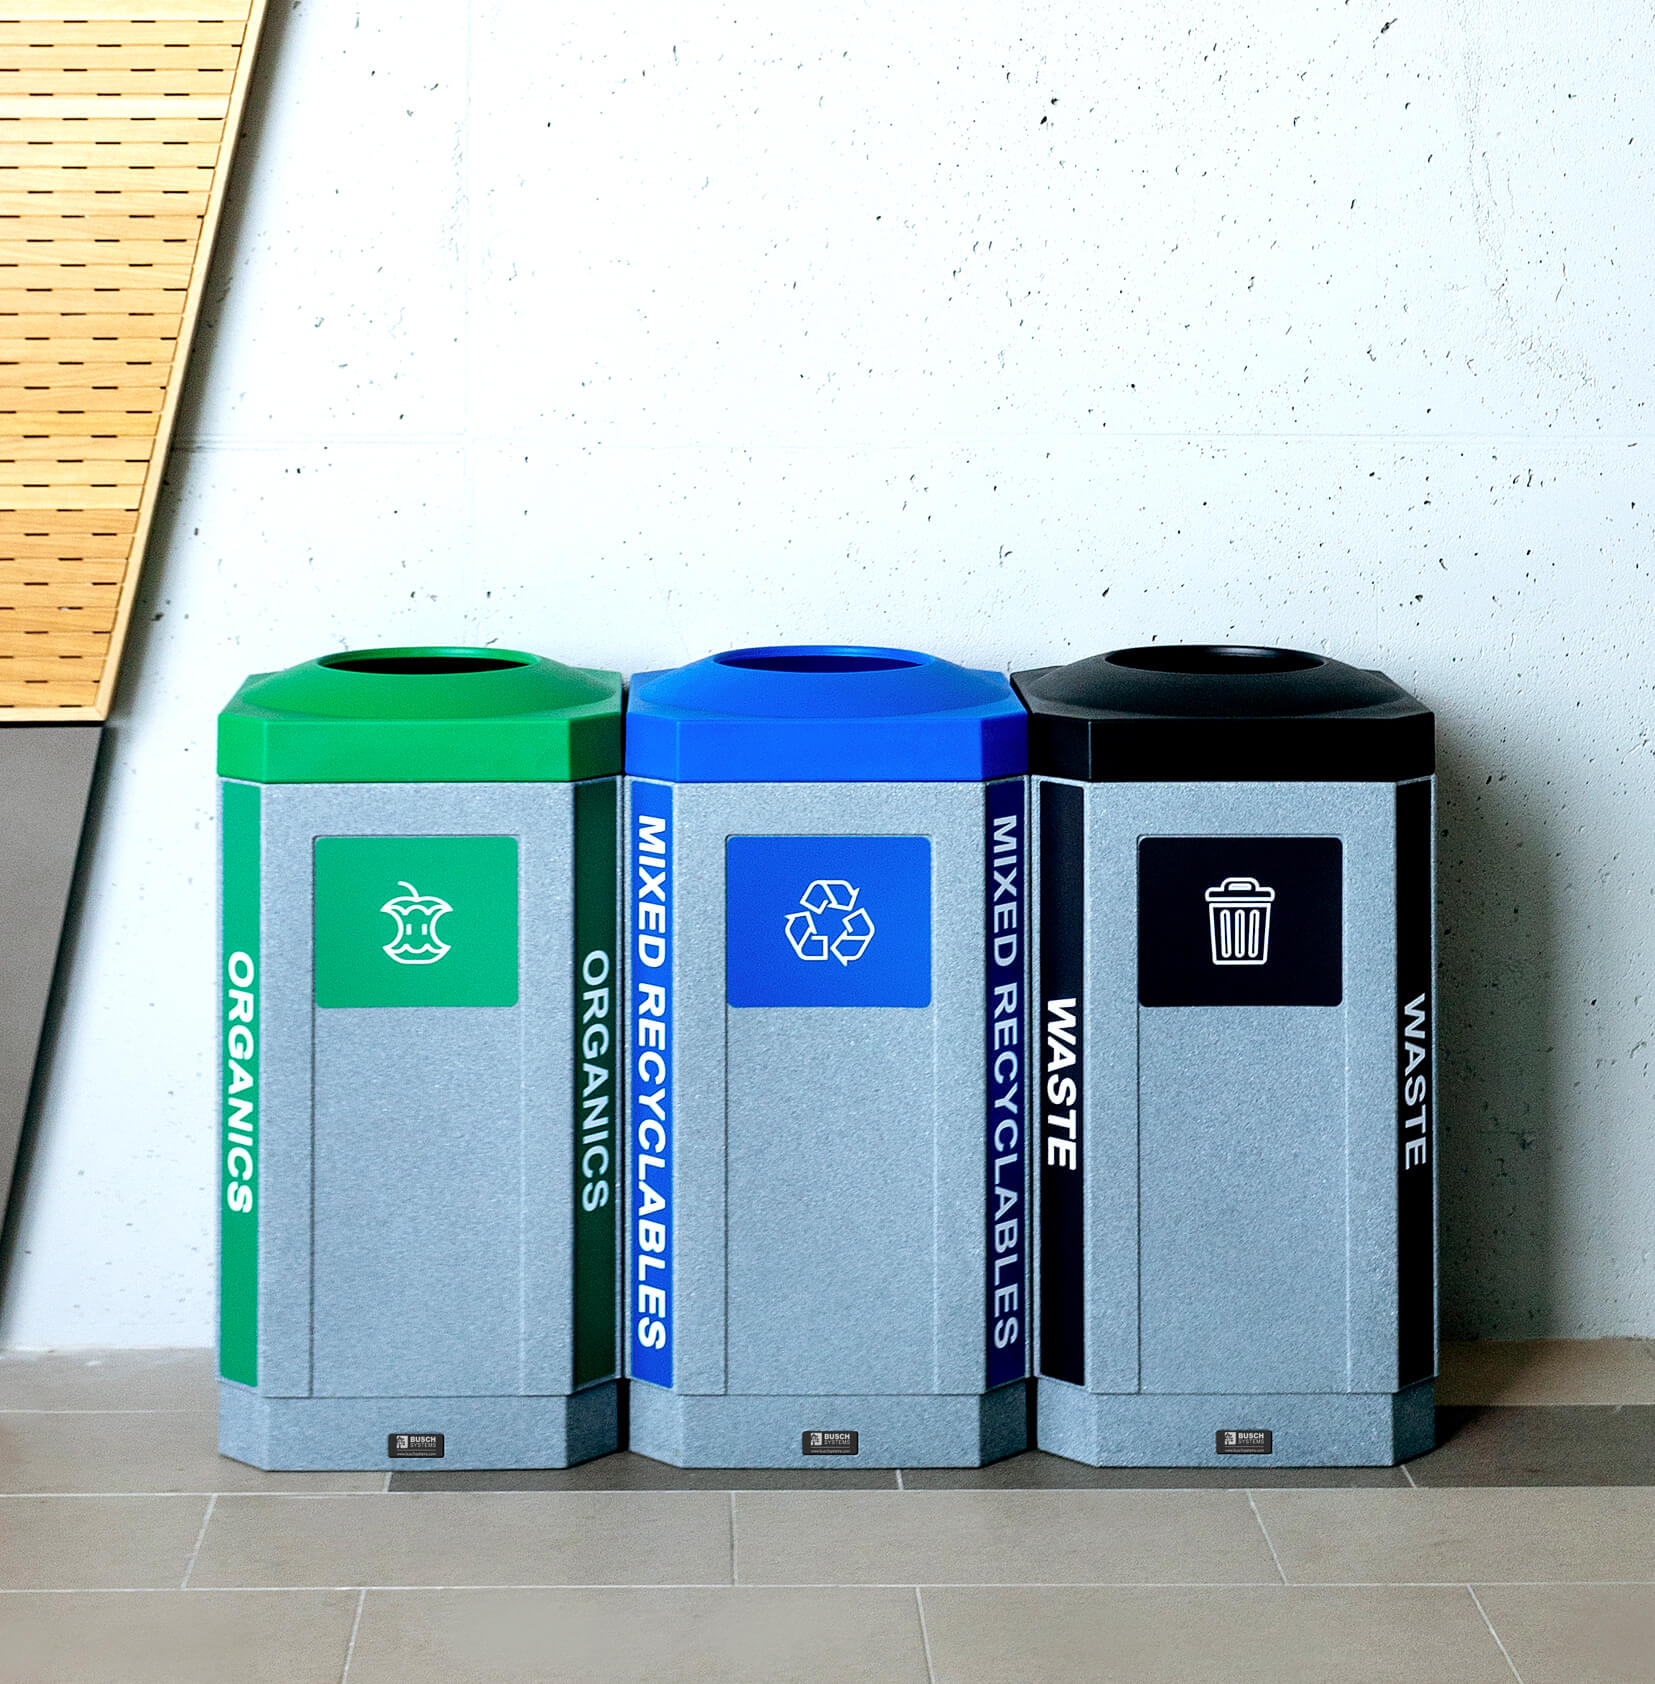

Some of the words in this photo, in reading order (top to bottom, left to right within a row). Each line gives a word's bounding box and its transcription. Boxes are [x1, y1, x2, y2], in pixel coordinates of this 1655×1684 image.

[638, 815, 667, 966] MIXED
[992, 814, 1018, 966] MIXED
[227, 951, 254, 1213] ORGANICS
[582, 950, 609, 1212] ORGANICS
[638, 983, 667, 1350] RECYCLABLES
[992, 982, 1018, 1350] RECYCLABLES
[1046, 997, 1077, 1171] WASTE
[1403, 993, 1427, 1170] WASTE
